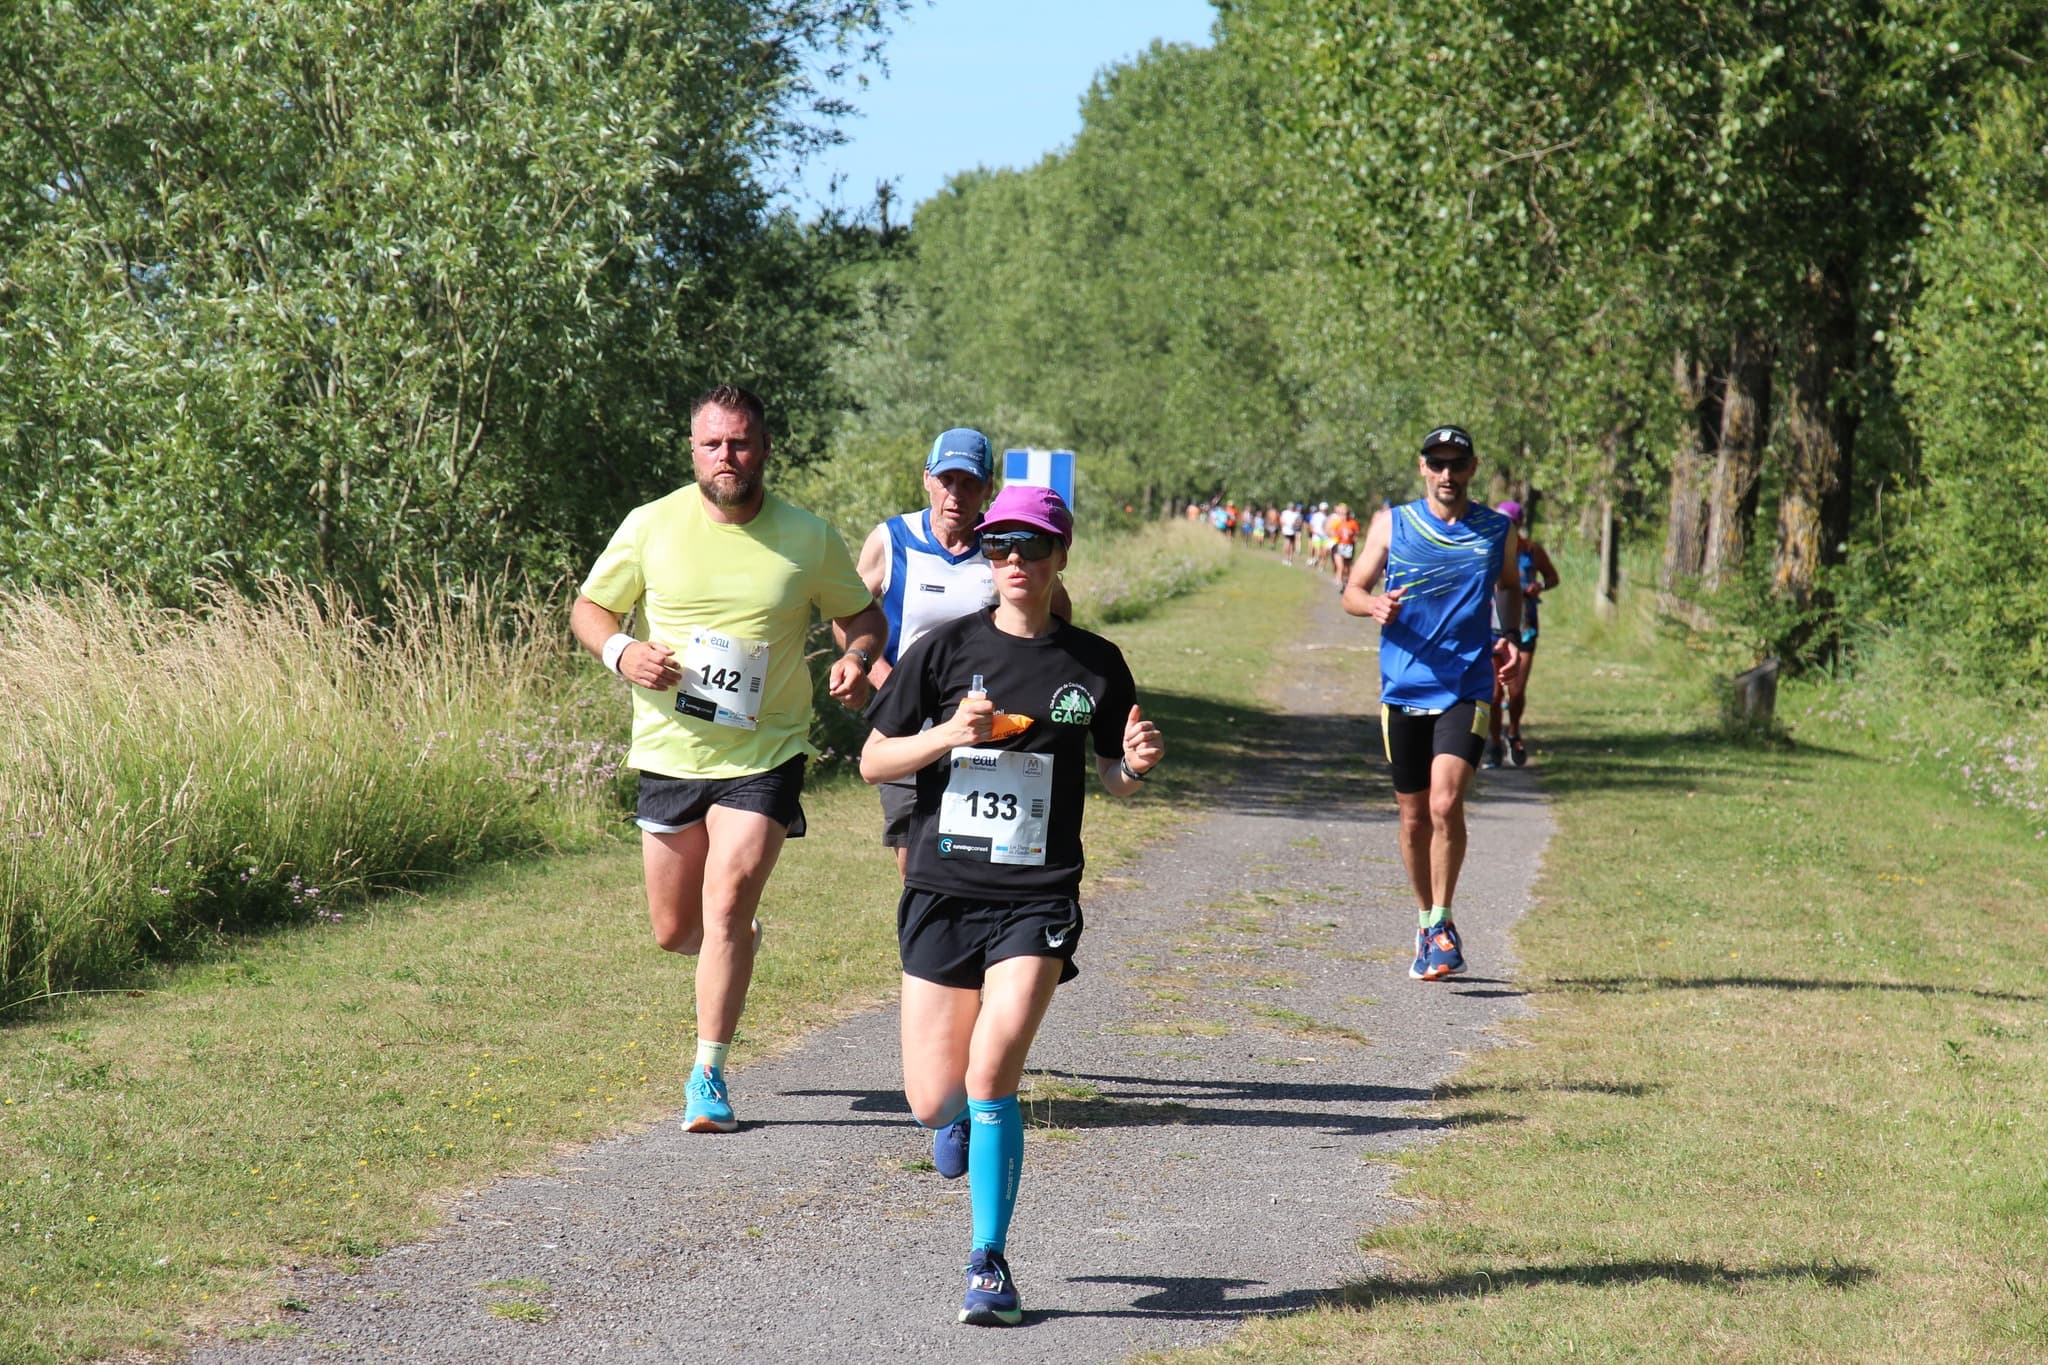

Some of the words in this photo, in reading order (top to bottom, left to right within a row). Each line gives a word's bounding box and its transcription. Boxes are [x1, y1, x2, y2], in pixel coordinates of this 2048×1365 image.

[701, 664, 741, 693] 142
[1051, 710, 1092, 726] CACB
[966, 790, 1018, 821] 133
